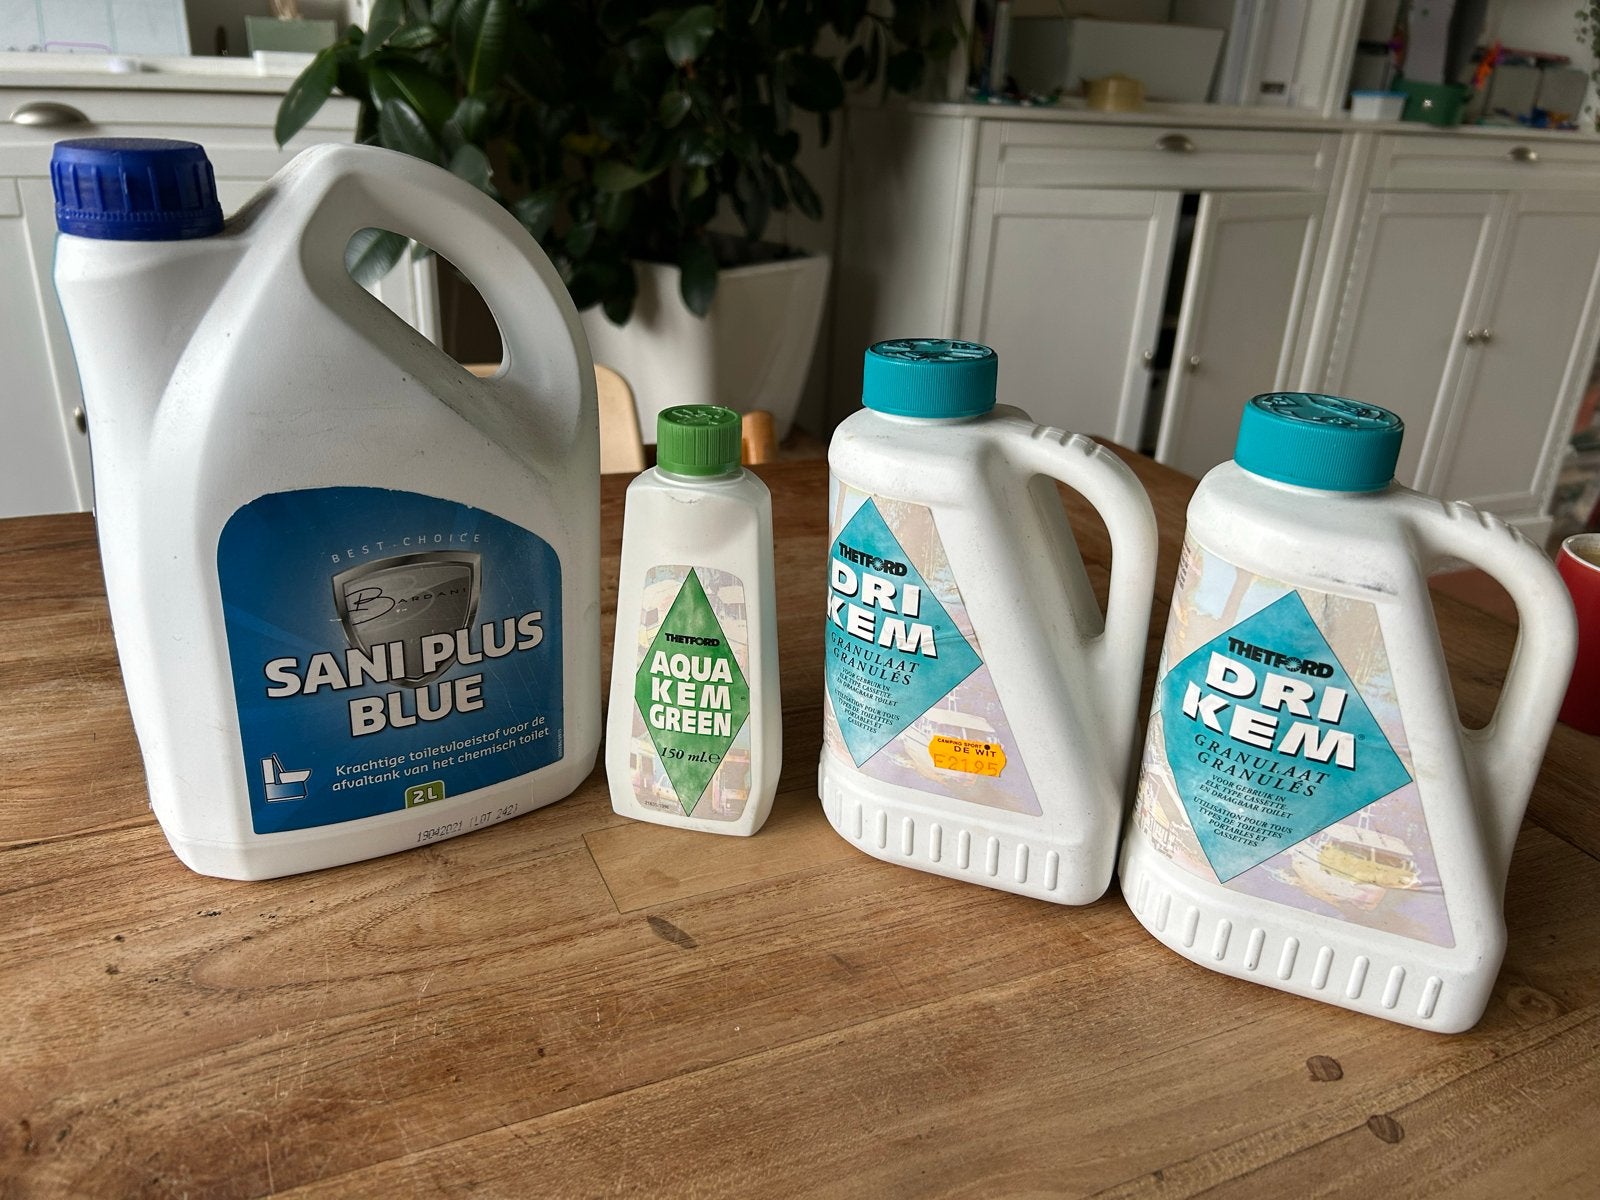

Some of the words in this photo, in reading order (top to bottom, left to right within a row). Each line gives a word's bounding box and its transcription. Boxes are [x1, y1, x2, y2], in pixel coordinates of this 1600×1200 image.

[839, 541, 908, 577] THETFORD
[831, 557, 921, 618] DRI
[827, 586, 938, 658] KEM
[264, 641, 405, 698] SANI
[421, 610, 545, 674] PLUS
[665, 632, 720, 647] THETFORD
[831, 631, 919, 673] GRANULAAT
[650, 650, 733, 683] AQUA
[833, 647, 911, 685] GRANULÉS
[1228, 636, 1334, 679] THETFORD
[349, 673, 485, 737] BLUE
[651, 676, 731, 710] KEM
[875, 695, 898, 707] TOILET
[1205, 651, 1348, 725] DRI
[649, 704, 731, 737] GREEN
[848, 717, 877, 733] CASSETTES
[861, 709, 893, 725] TOILETTES
[882, 711, 900, 721] TOUS
[1182, 680, 1356, 771] KEM
[332, 770, 401, 791] afvaltank
[404, 764, 428, 776] van
[432, 756, 455, 770] het
[457, 739, 516, 763] chemisch
[519, 727, 549, 744] toilet
[335, 755, 405, 776] Krachtige
[408, 728, 501, 761] toiletvloeistof
[502, 721, 529, 736] voor
[531, 716, 545, 727] de
[661, 747, 684, 759] 150
[937, 738, 962, 746] CAMPING
[954, 745, 969, 754] DE
[975, 749, 996, 757] WIT
[1194, 733, 1330, 785] GRANULAAT
[1197, 752, 1317, 797] GRANULÉS
[1205, 780, 1221, 790] ELK
[1222, 786, 1243, 798] TYPE
[1212, 774, 1234, 788] VOOR
[1235, 784, 1274, 800] GEBRUIK
[1193, 796, 1243, 820] UTILISATION
[1244, 816, 1268, 828] POUR
[1268, 823, 1293, 834] TOUS
[1200, 784, 1211, 793] EN
[1211, 790, 1260, 811] DRAAGBAAR
[1260, 807, 1294, 819] TOILET
[1199, 807, 1223, 820] TYPES
[1223, 818, 1236, 826] DE
[1237, 822, 1284, 839] TOILETTES
[1208, 819, 1255, 839] PORTABLES
[1213, 828, 1258, 847] CASSETTES
